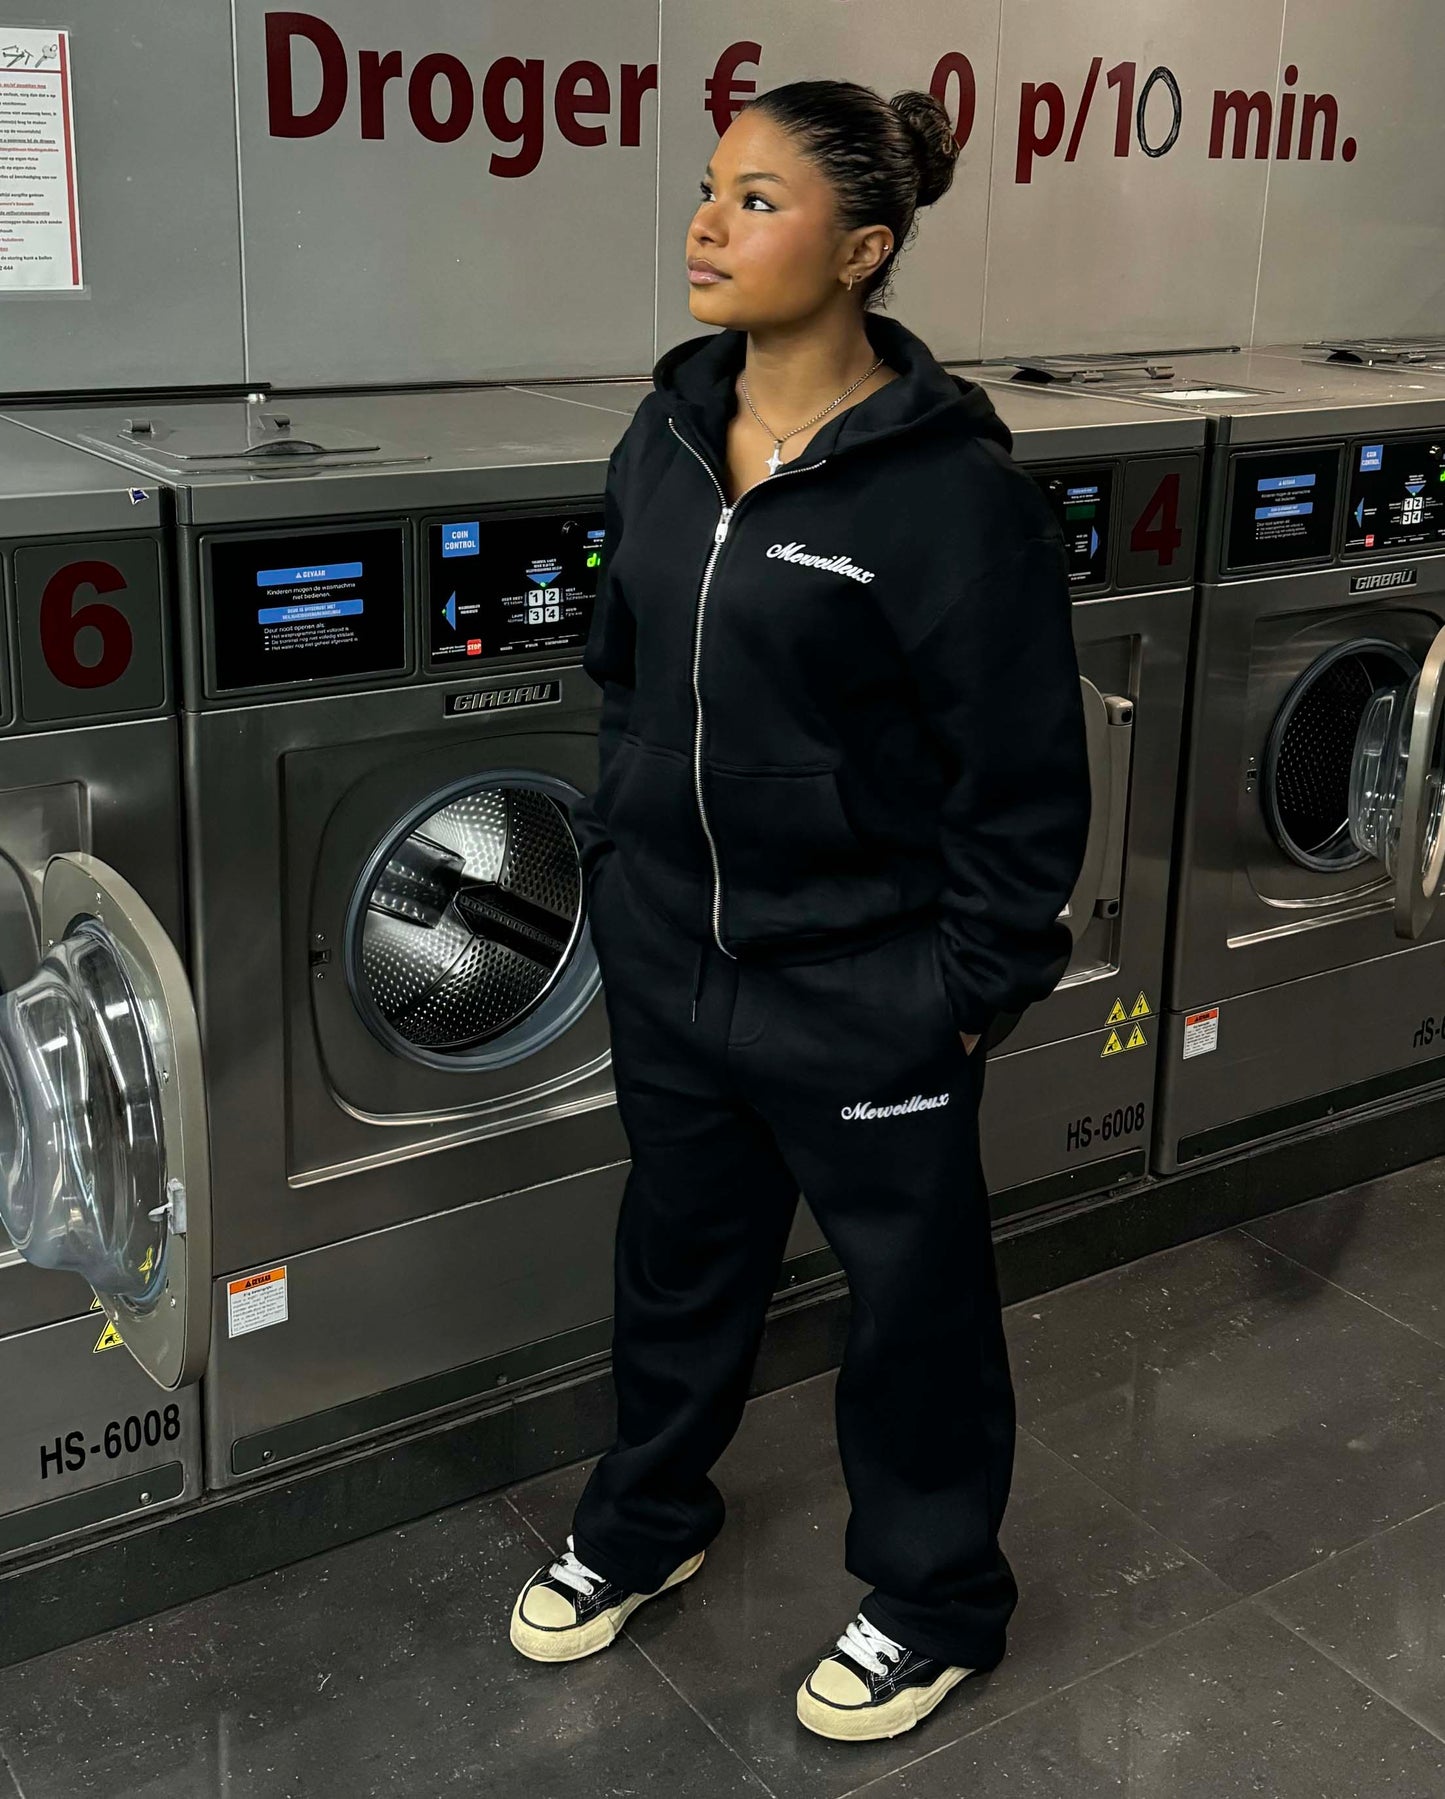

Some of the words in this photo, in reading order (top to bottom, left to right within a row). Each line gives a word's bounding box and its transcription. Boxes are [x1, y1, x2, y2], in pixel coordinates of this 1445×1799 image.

[264, 11, 658, 179] Droger
[704, 41, 762, 138] €
[1015, 56, 1182, 184] p/10
[1208, 64, 1357, 163] min.
[1131, 473, 1182, 566] 4
[444, 540, 476, 550] CONTROL
[451, 531, 469, 540] COIN
[1356, 570, 1413, 589] GIRBAU
[533, 593, 538, 603] 1
[548, 591, 556, 601] 2
[532, 611, 540, 621] 3
[548, 609, 556, 619] 4
[40, 560, 134, 689] 6
[467, 642, 482, 651] STOP
[453, 684, 551, 711] GIRBAU
[841, 1093, 949, 1120] Merveilleux
[1066, 1102, 1145, 1152] HS-6008
[40, 1403, 180, 1479] HS-6008
